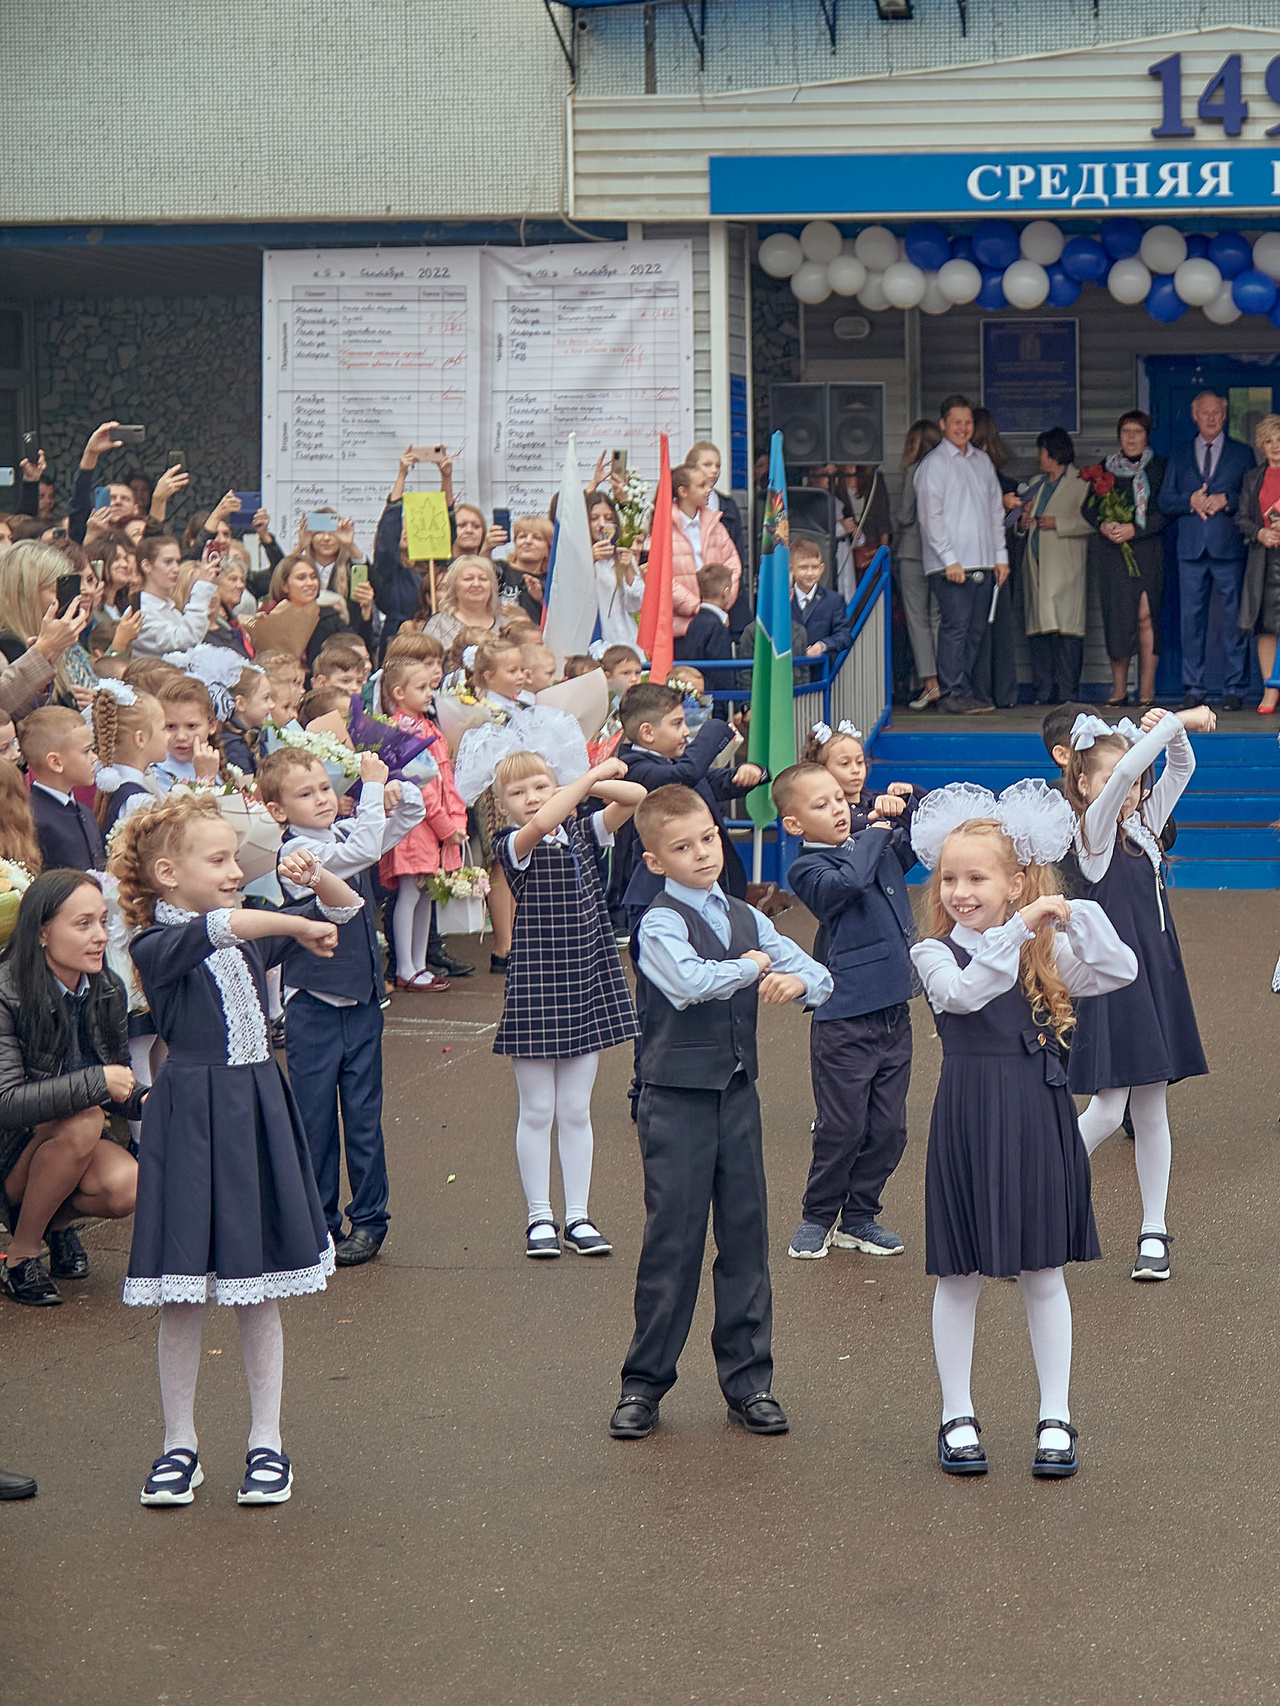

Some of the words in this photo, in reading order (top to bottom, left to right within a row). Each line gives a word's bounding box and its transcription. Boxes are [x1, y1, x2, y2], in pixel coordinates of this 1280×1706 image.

[966, 160, 1234, 207] СРЕДНЯЯ
[418, 267, 450, 279] 2022
[629, 263, 662, 276] 2022
